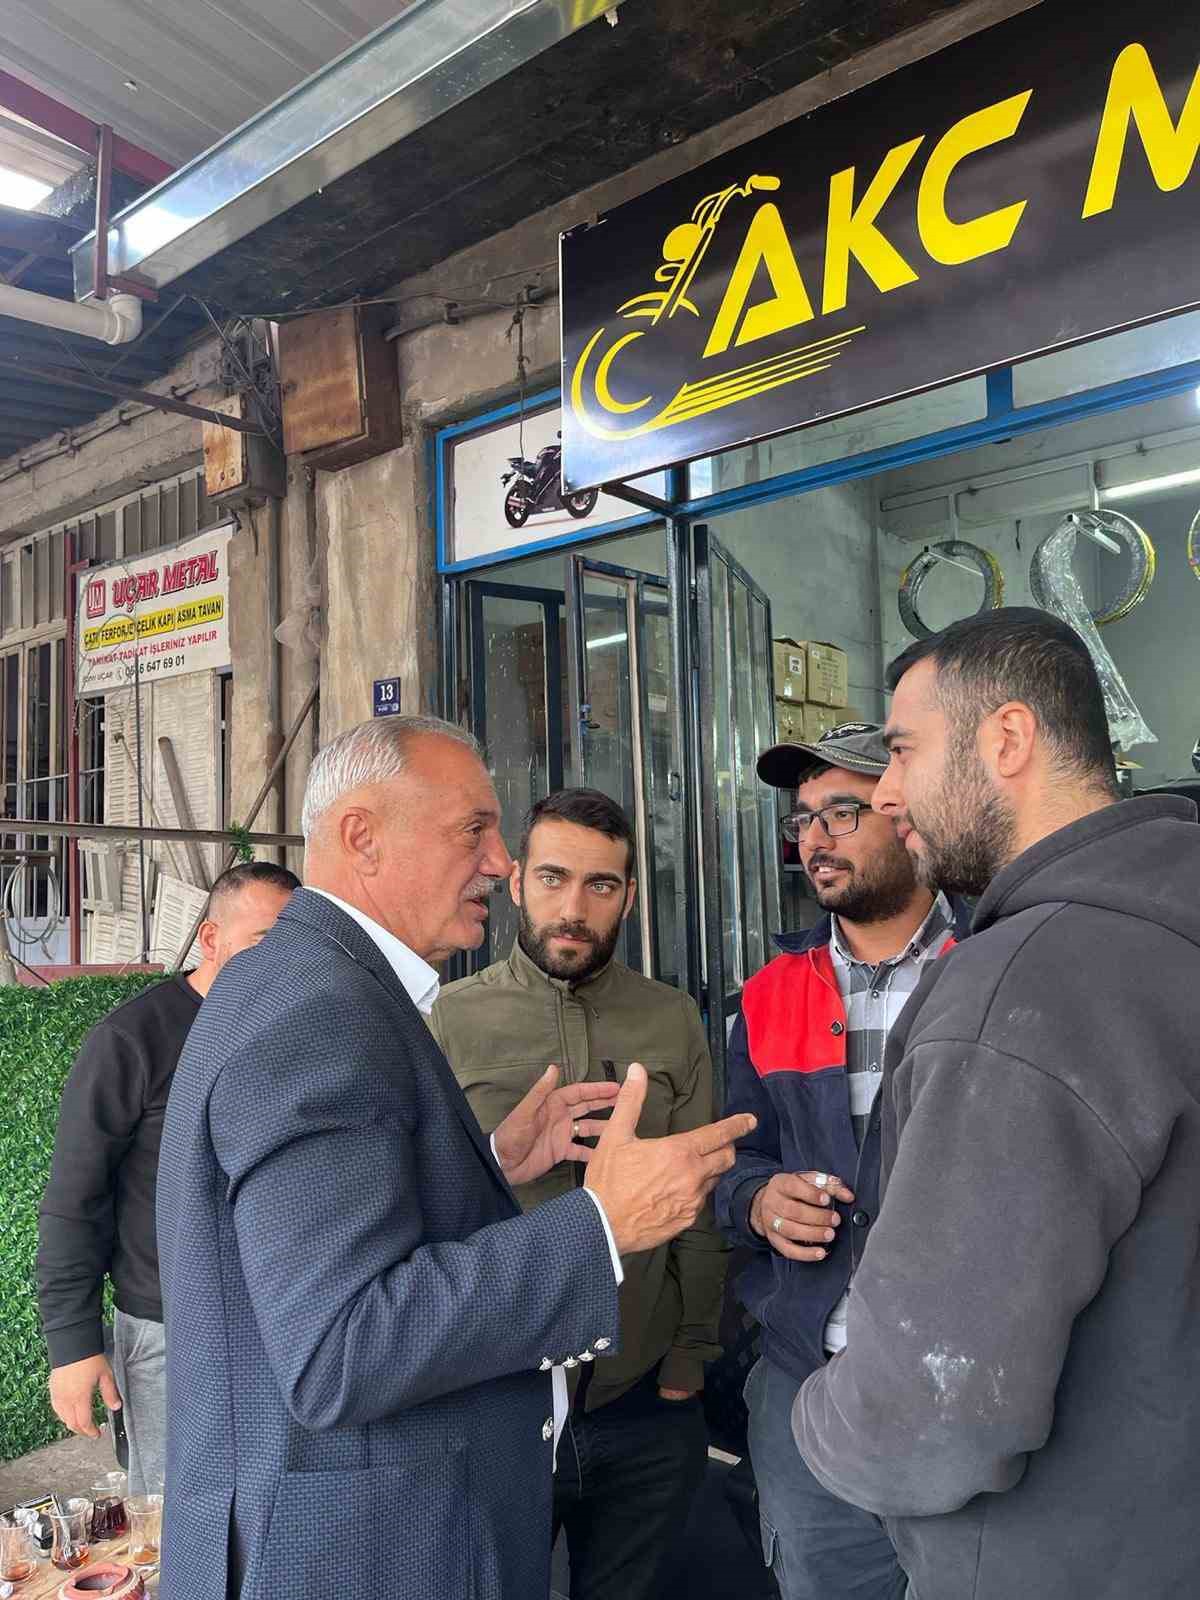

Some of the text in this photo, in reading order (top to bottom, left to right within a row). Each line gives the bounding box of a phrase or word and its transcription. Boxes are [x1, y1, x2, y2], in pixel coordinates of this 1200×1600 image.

[702, 89, 1033, 358] AKC
[112, 550, 218, 613] UÇAR METAL
[101, 623, 134, 642] FERFORJE
[158, 613, 174, 627] KAPI
[177, 607, 196, 623] ASMA
[198, 599, 221, 616] TAVAN
[187, 630, 217, 646] YAPILIR
[125, 662, 144, 678] 056
[146, 659, 161, 673] 647
[163, 657, 173, 669] 69
[175, 654, 185, 667] 01
[380, 684, 393, 701] 13
